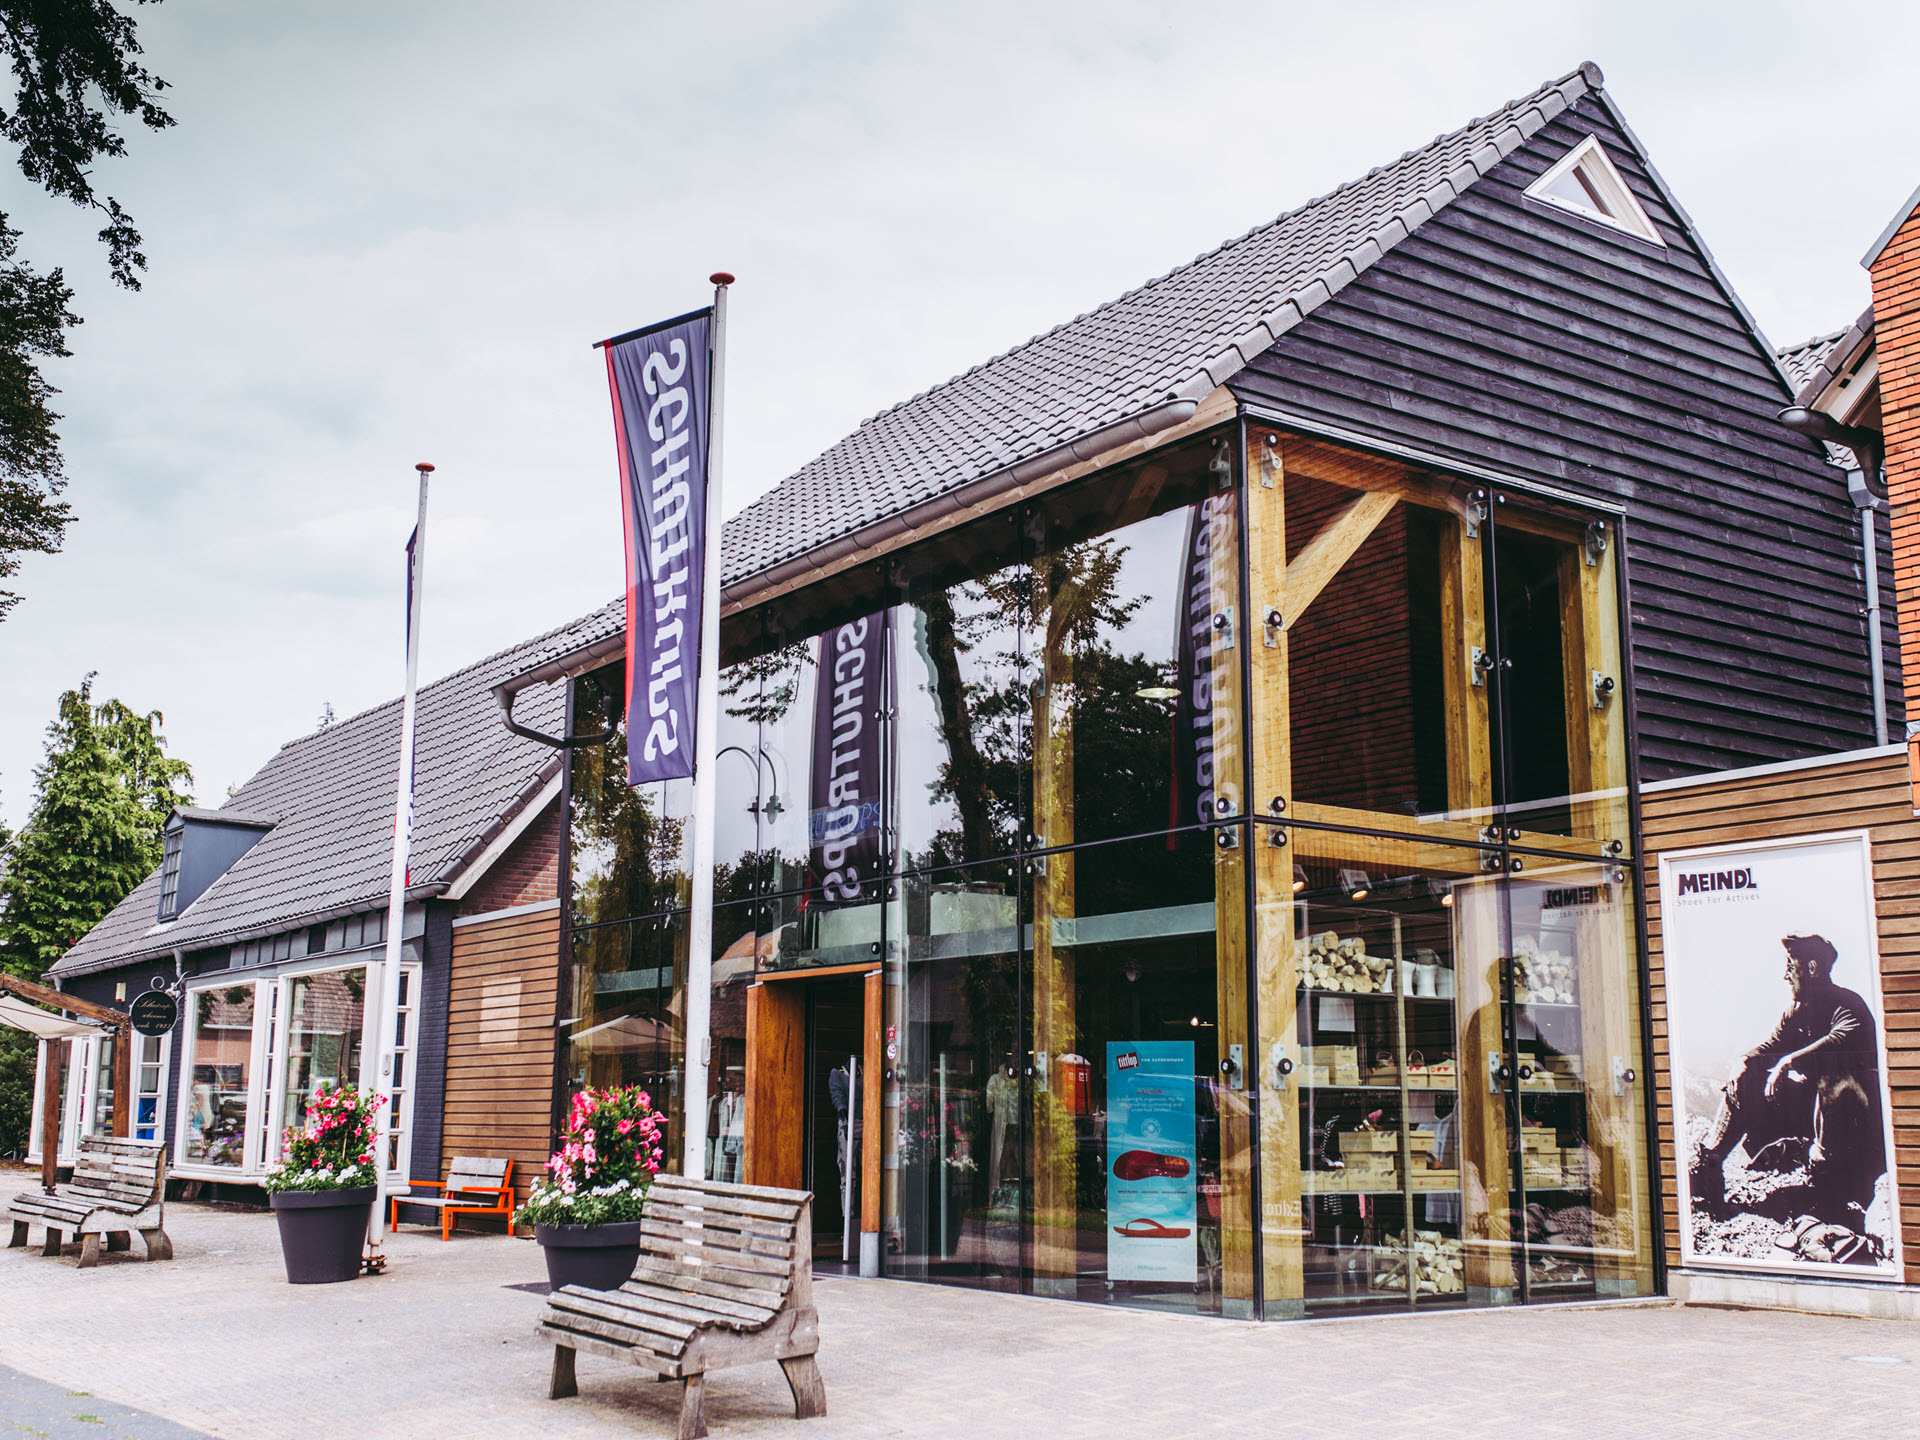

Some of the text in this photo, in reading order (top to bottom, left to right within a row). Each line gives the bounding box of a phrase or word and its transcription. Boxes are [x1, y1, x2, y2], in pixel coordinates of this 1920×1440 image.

[1678, 867, 1757, 897] MEINDL
[1677, 893, 1760, 907] Shoes For Actives
